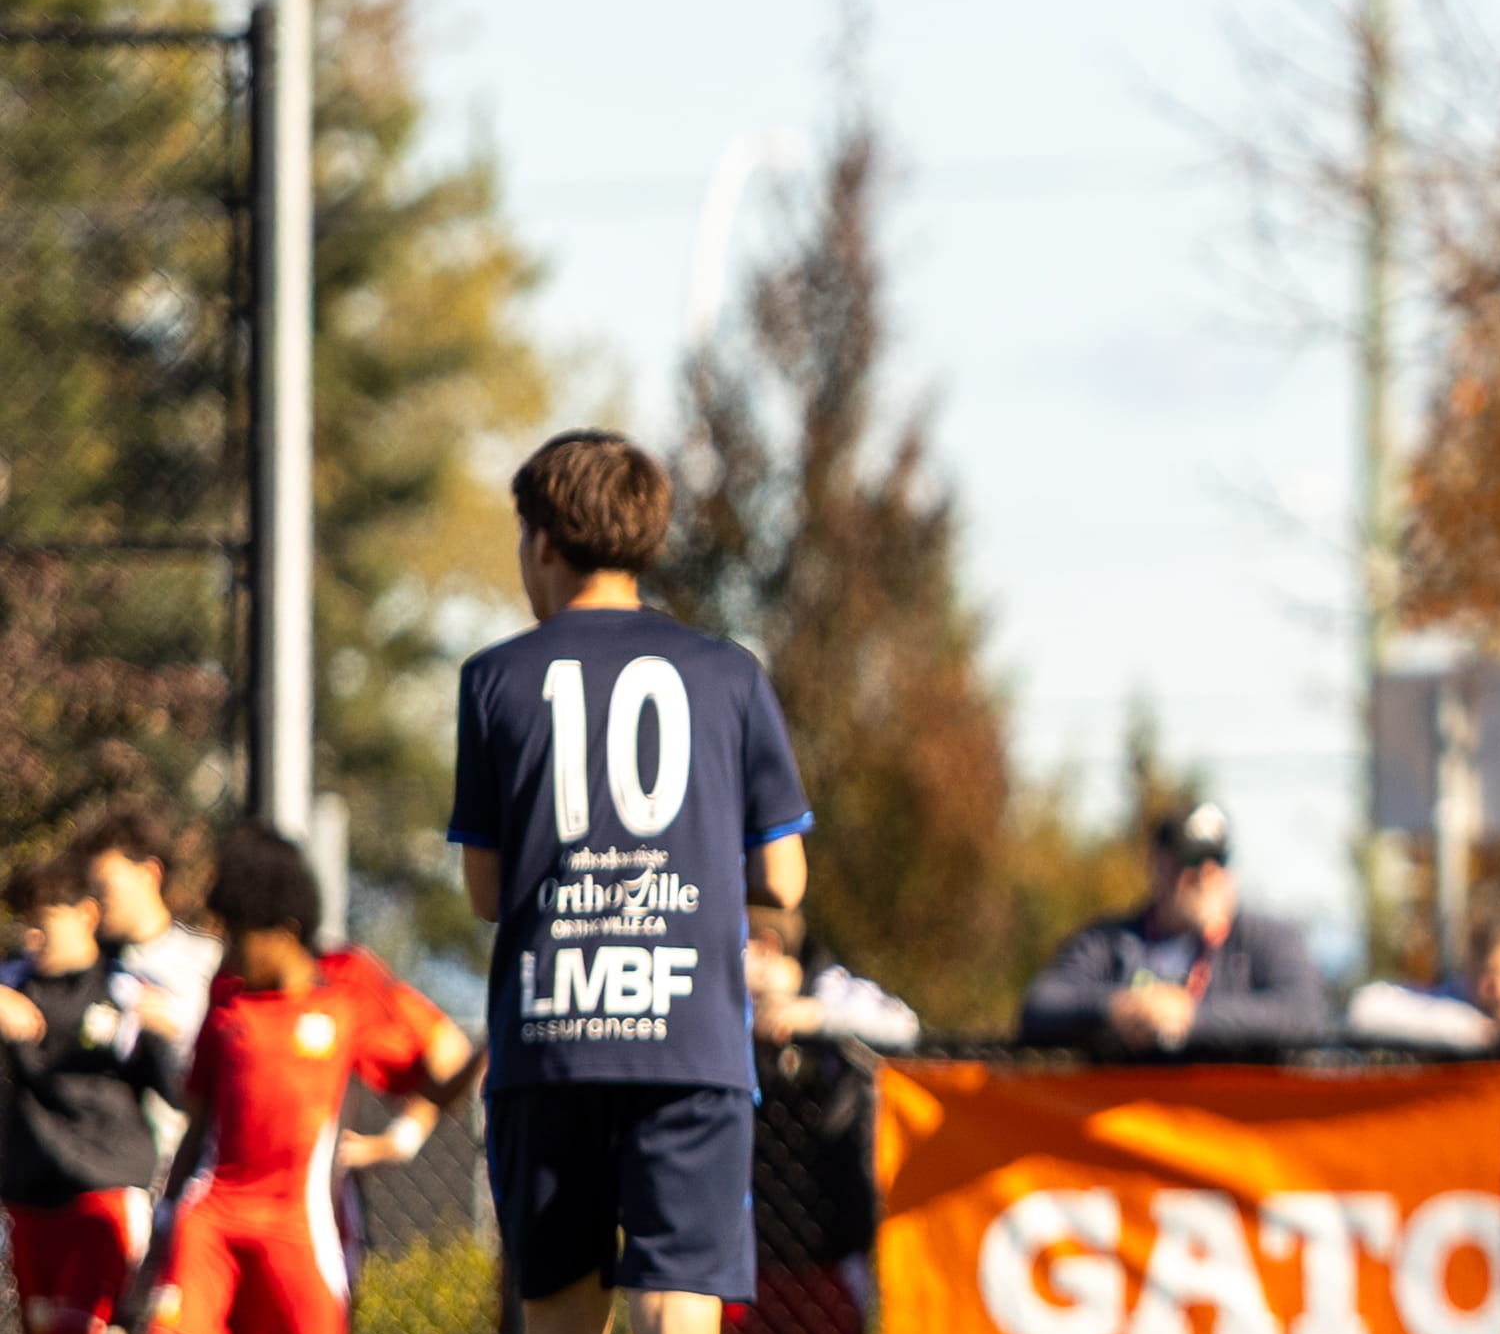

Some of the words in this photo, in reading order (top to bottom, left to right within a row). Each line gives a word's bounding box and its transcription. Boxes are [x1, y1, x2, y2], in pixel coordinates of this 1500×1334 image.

[542, 655, 692, 845] 10
[519, 946, 699, 1018] LMBF
[520, 1014, 668, 1044] assurances
